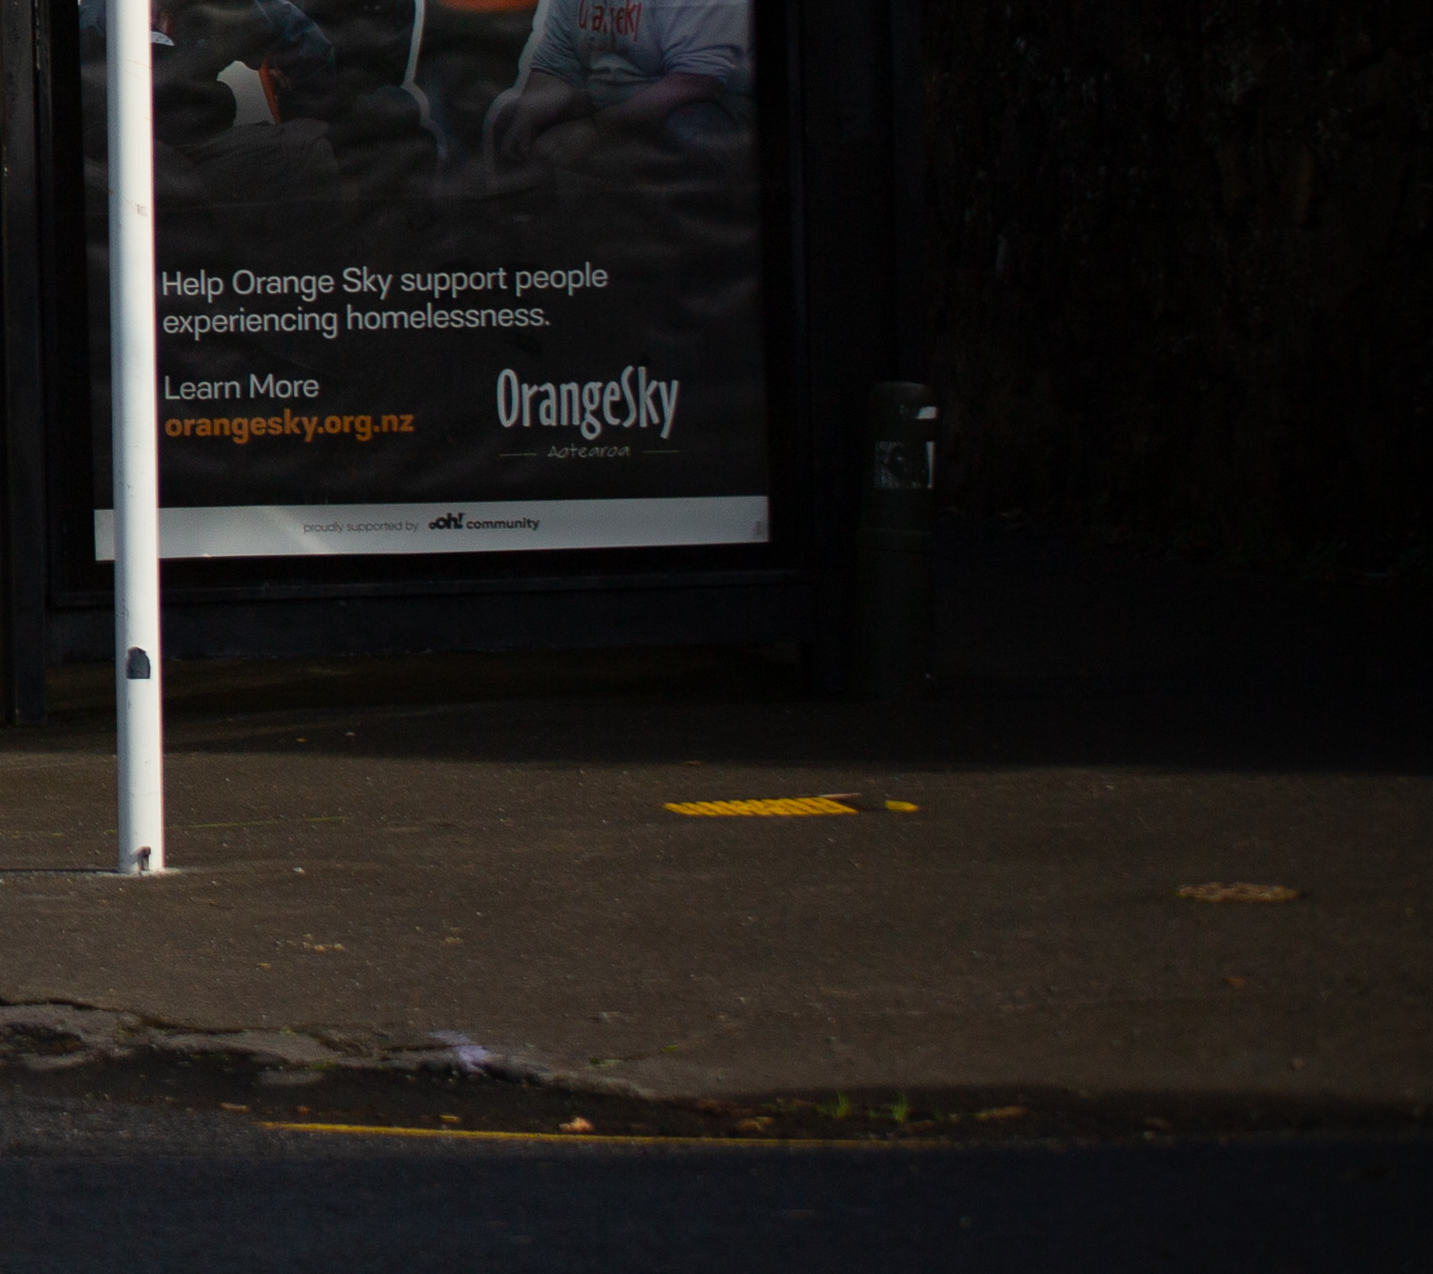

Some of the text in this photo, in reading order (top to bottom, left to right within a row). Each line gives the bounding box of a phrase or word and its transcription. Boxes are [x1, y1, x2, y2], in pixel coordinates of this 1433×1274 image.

[162, 262, 609, 302] Help Orange Sky support people
[162, 302, 550, 341] experiencing homelessness.
[164, 373, 319, 402] Learn More
[496, 365, 680, 440] OrangeSky
[164, 409, 415, 445] orangesky.org.nz
[547, 443, 631, 459] Aotearoa
[303, 522, 343, 534] proudly
[346, 521, 402, 533] supported
[405, 521, 419, 533] by
[466, 517, 540, 531] community
